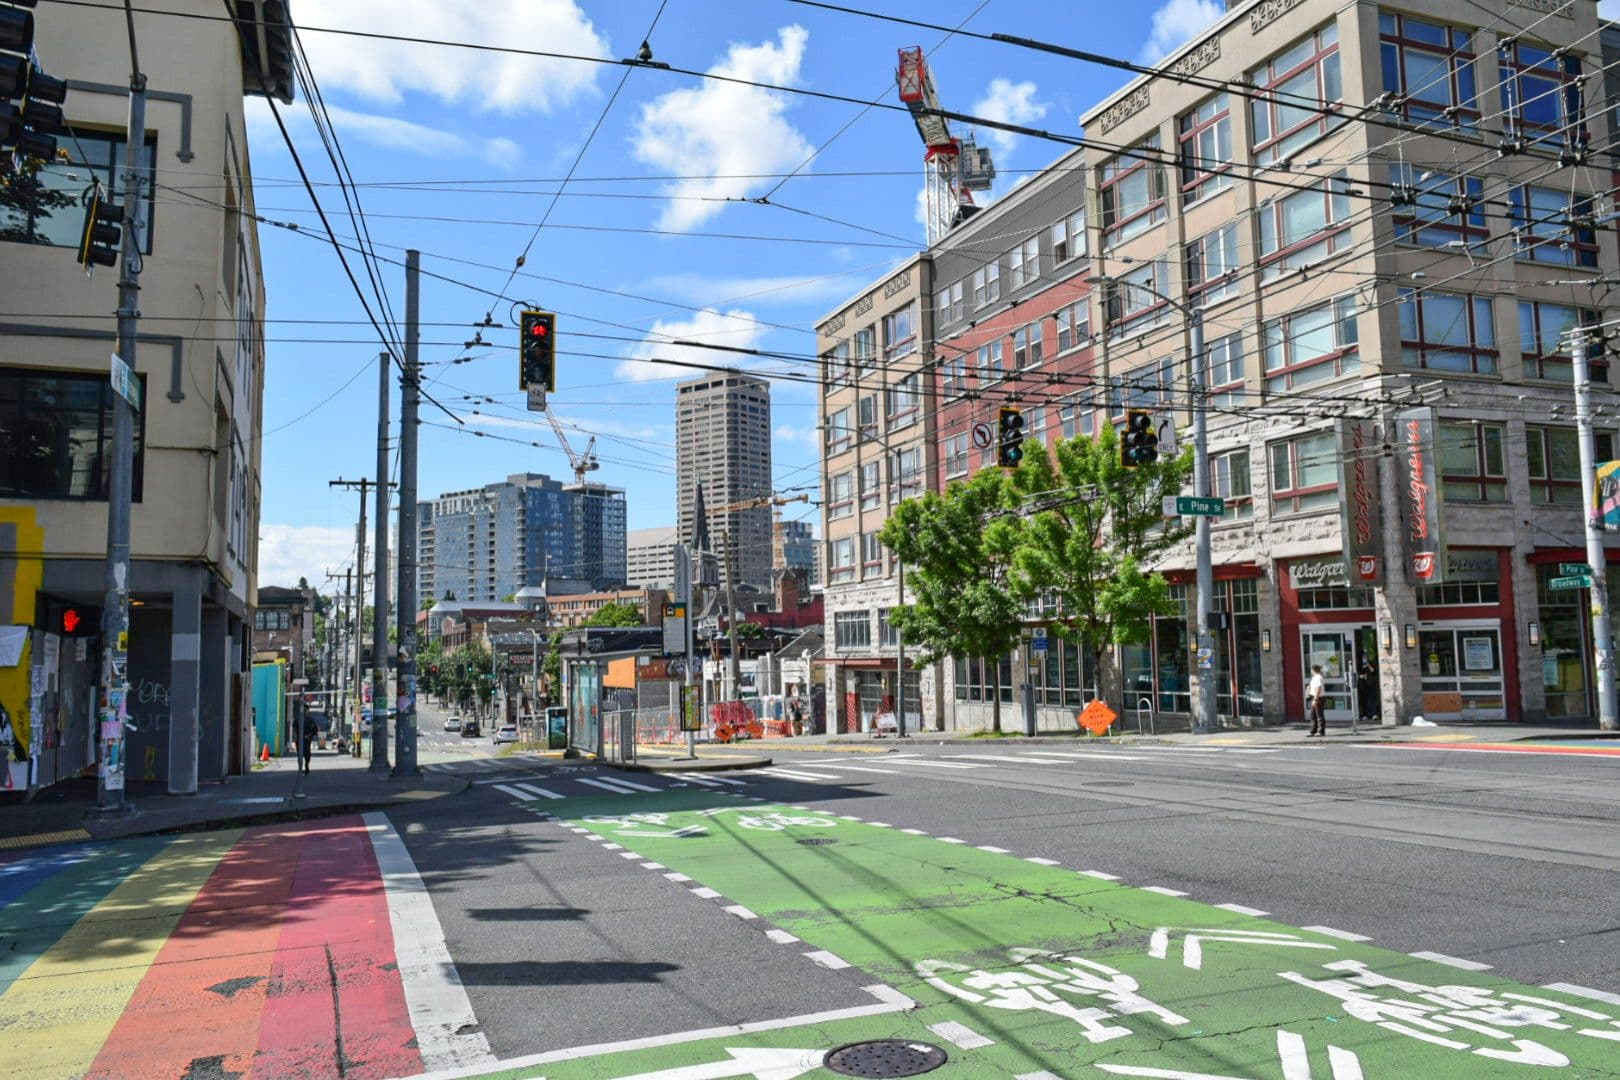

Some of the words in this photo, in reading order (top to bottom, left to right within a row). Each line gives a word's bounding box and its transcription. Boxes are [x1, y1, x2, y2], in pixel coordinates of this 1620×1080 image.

[1179, 502, 1185, 511] E
[1191, 500, 1209, 512] Pine
[1214, 504, 1221, 512] St
[1352, 422, 1373, 544] Walgreens
[1407, 418, 1429, 542] Walgreens
